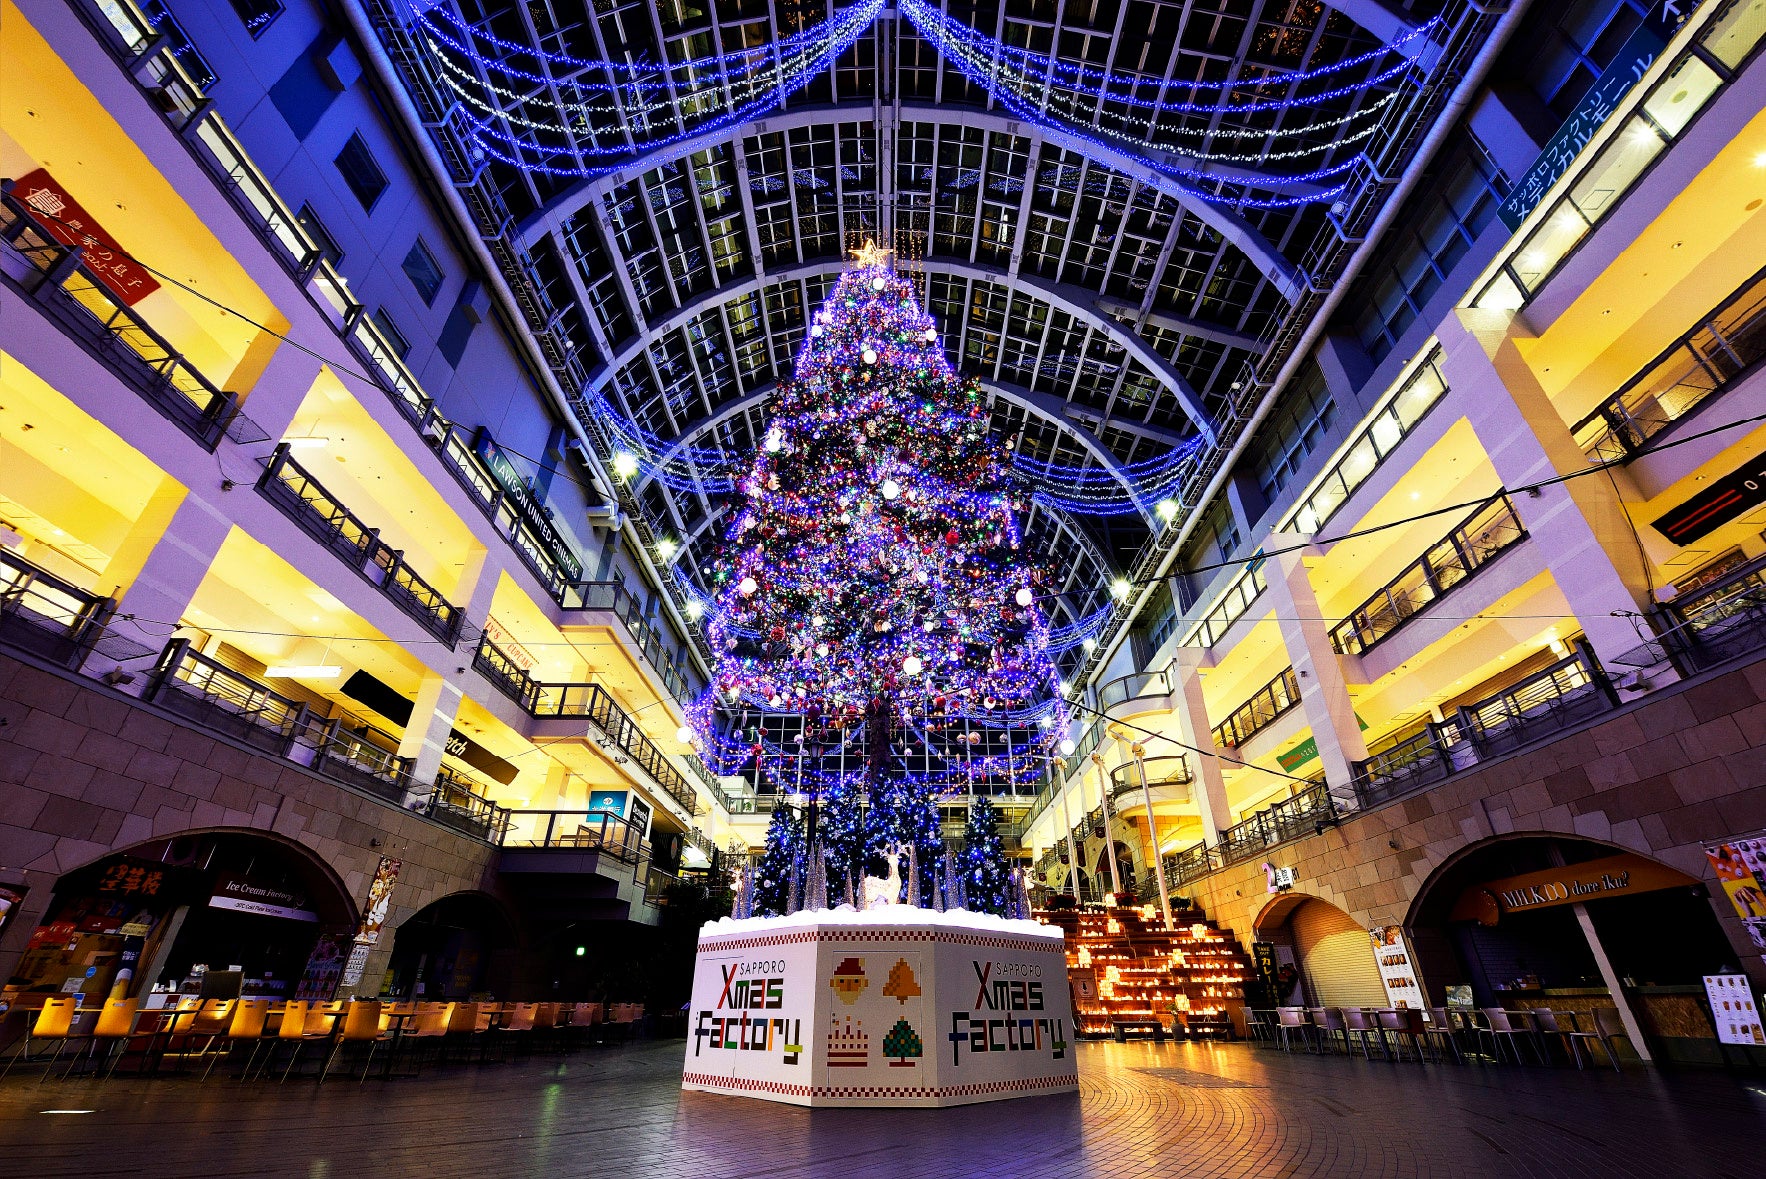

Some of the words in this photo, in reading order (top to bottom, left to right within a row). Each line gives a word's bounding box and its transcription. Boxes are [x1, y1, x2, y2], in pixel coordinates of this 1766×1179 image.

[66, 219, 143, 288] 農家の息子
[493, 456, 529, 508] LAWSON
[527, 501, 552, 542] UNITED
[552, 538, 579, 580] CINEMAS
[507, 644, 533, 671] CUPCAKE
[226, 880, 240, 891] Ice
[240, 883, 266, 896] Cream
[1571, 881, 1599, 895] dore
[1601, 871, 1629, 890] iku?
[740, 960, 786, 975] SAPPORO
[996, 962, 1042, 977] SAPPORO
[717, 963, 784, 1009] Xmas
[972, 961, 1044, 1010] Xmas
